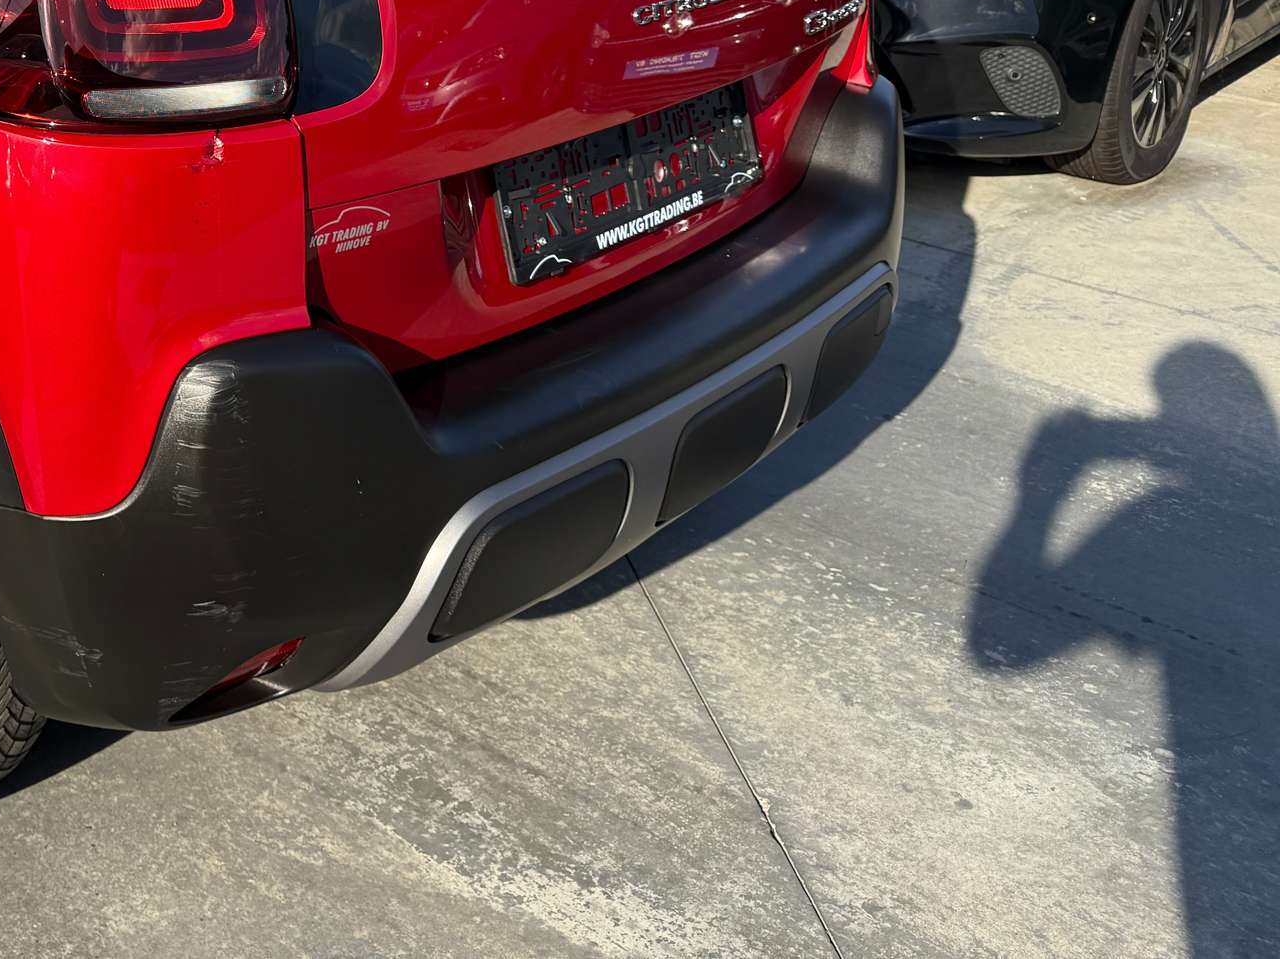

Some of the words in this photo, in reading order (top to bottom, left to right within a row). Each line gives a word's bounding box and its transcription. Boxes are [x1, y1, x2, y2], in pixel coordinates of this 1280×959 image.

[309, 232, 331, 249] KGT
[332, 222, 374, 243] TRADING
[376, 219, 390, 232] BV
[595, 189, 705, 250] WWW.KGTTRADING.BE
[335, 235, 372, 253] NINOVE
